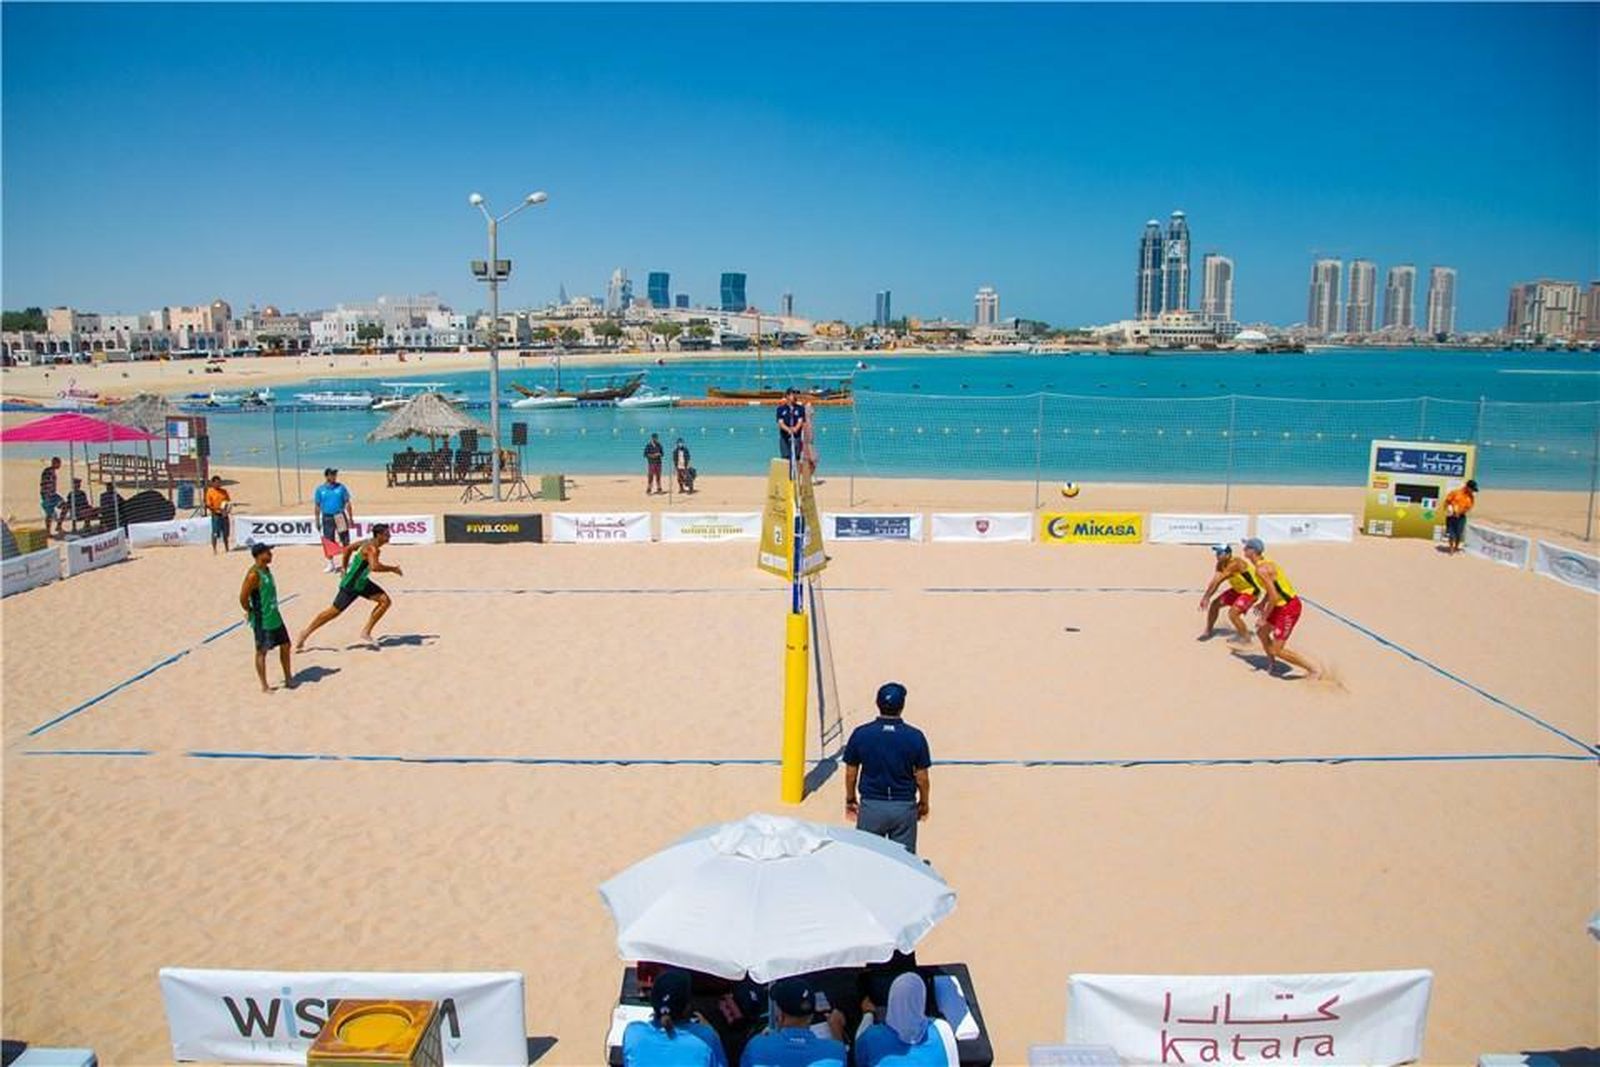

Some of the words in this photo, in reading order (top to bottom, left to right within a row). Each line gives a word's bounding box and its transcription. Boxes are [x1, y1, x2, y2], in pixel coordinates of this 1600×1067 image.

[251, 522, 312, 534] ZOOM
[366, 521, 427, 534] AKASS
[1161, 1029, 1335, 1063] katara
